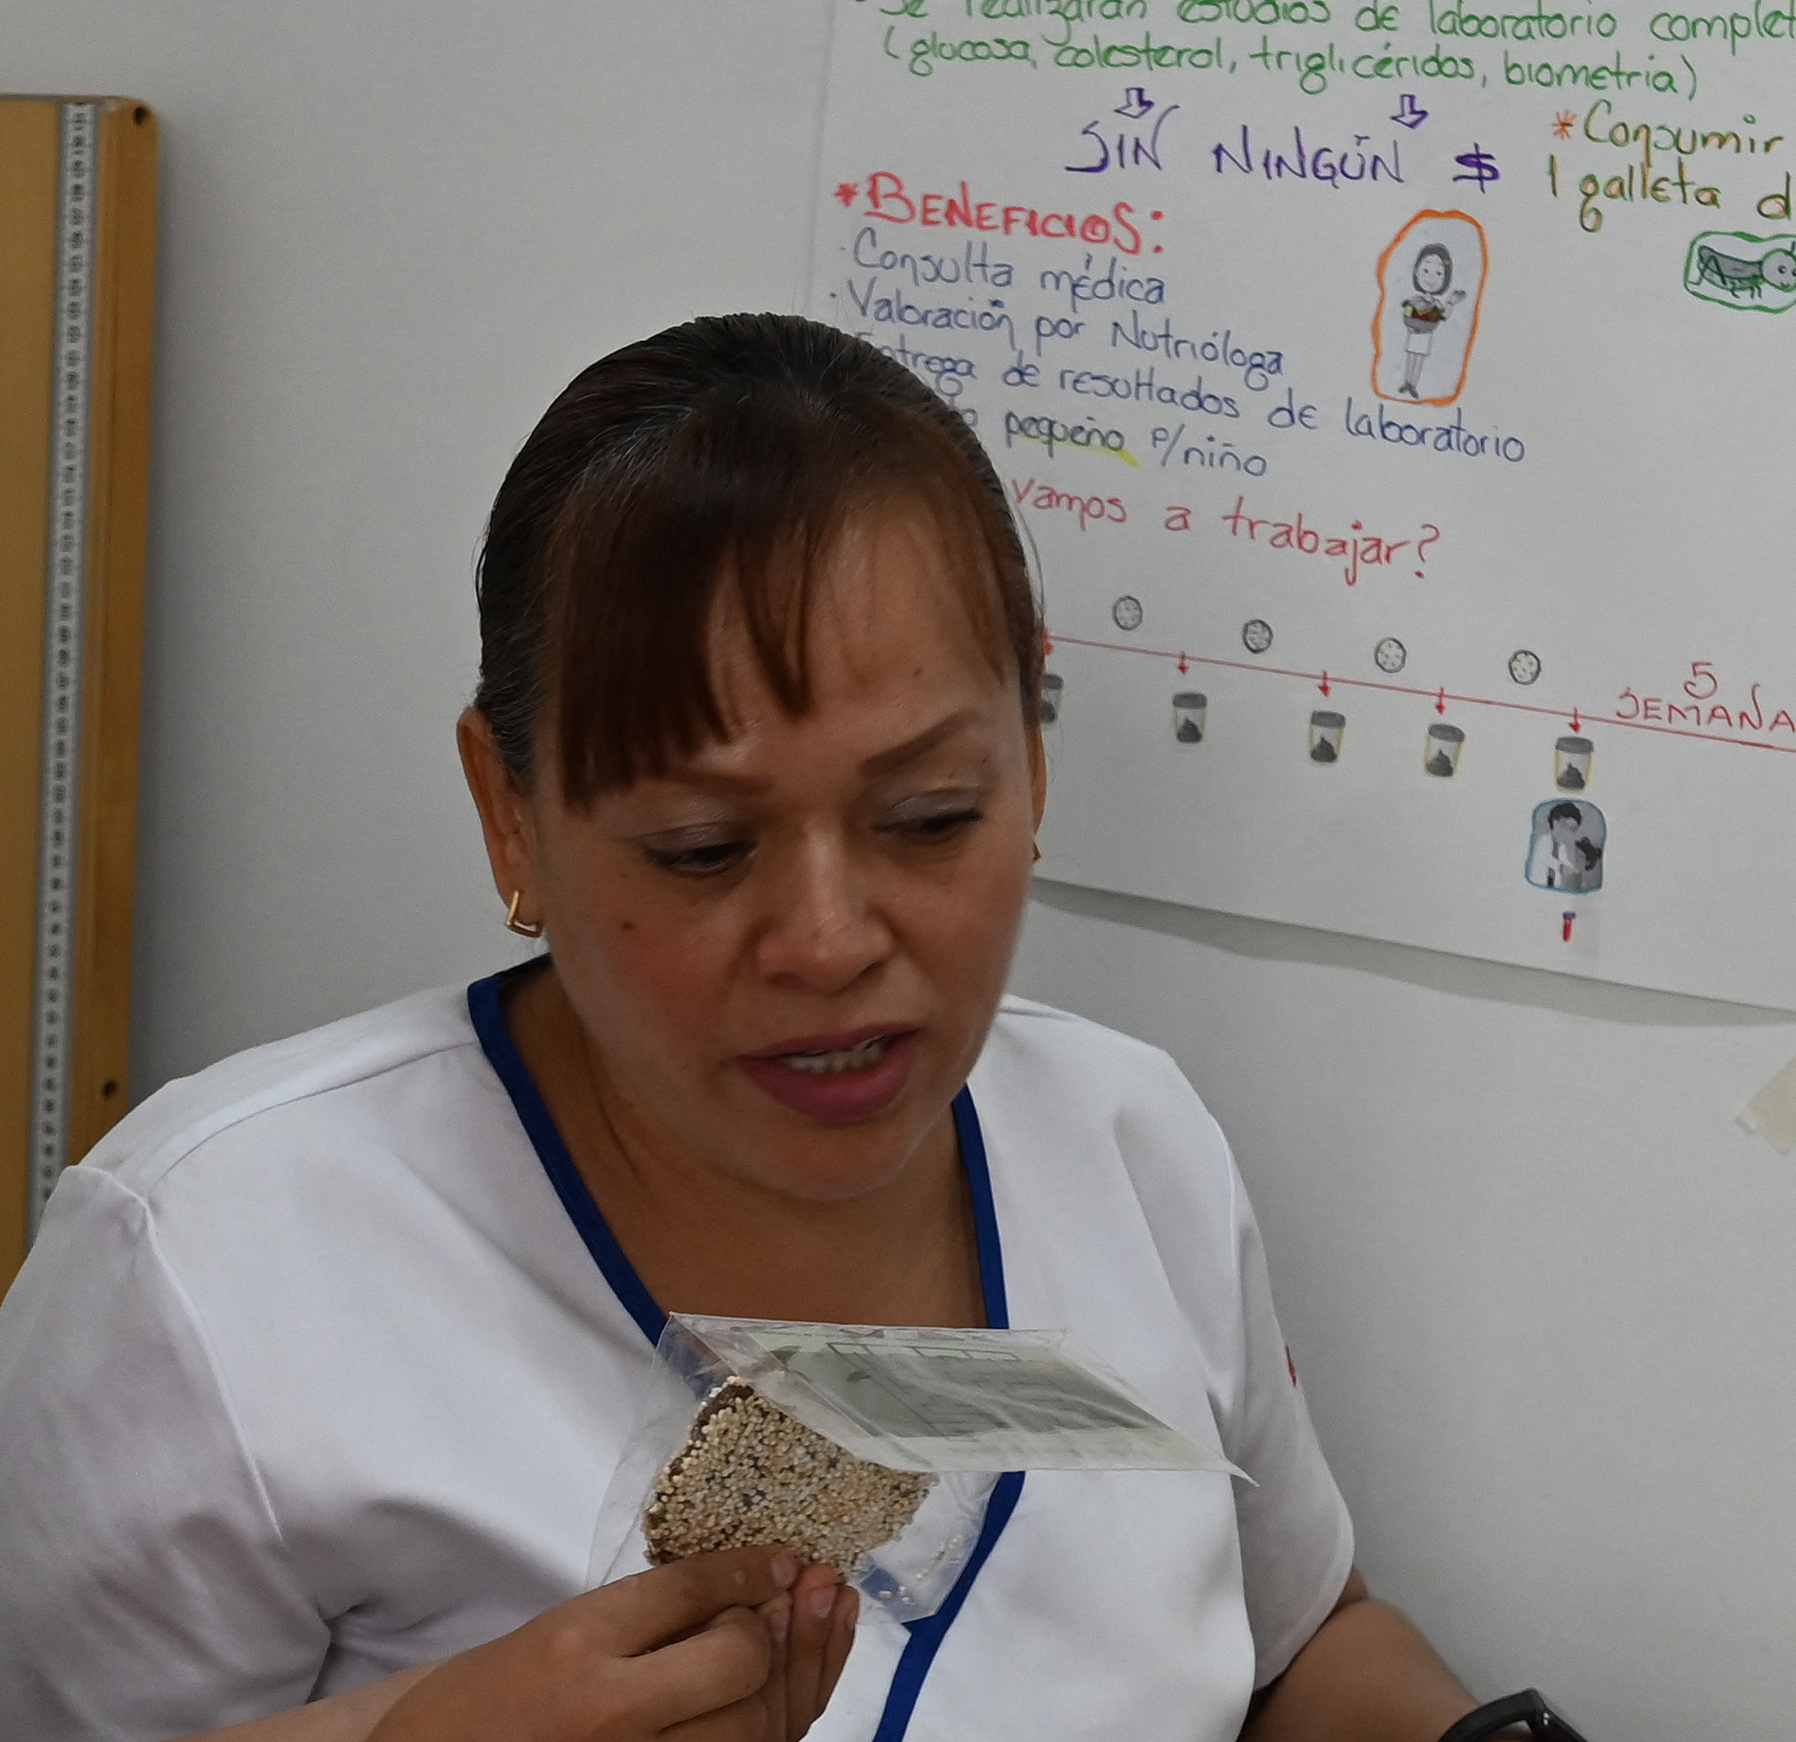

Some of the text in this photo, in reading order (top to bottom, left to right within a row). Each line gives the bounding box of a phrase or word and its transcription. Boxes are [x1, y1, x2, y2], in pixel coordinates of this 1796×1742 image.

[884, 25, 1038, 77] (glucosa,
[1055, 30, 1238, 74] colesterol,
[1355, 0, 1399, 31] de
[1429, 0, 1617, 41] laboratorio
[1065, 104, 1181, 174] SIN
[1452, 143, 1501, 193] $
[1579, 160, 1722, 233] galleta
[853, 226, 1167, 313] Consulta médica
[1035, 314, 1087, 358] por
[1110, 308, 1284, 392] Nutrióloga
[857, 331, 1527, 463] ntrega de resultados de laboratorio
[1004, 410, 1126, 460] pequeño
[1164, 505, 1193, 532] a
[1221, 495, 1441, 587] trabajar?
[1682, 660, 1720, 701] 5
